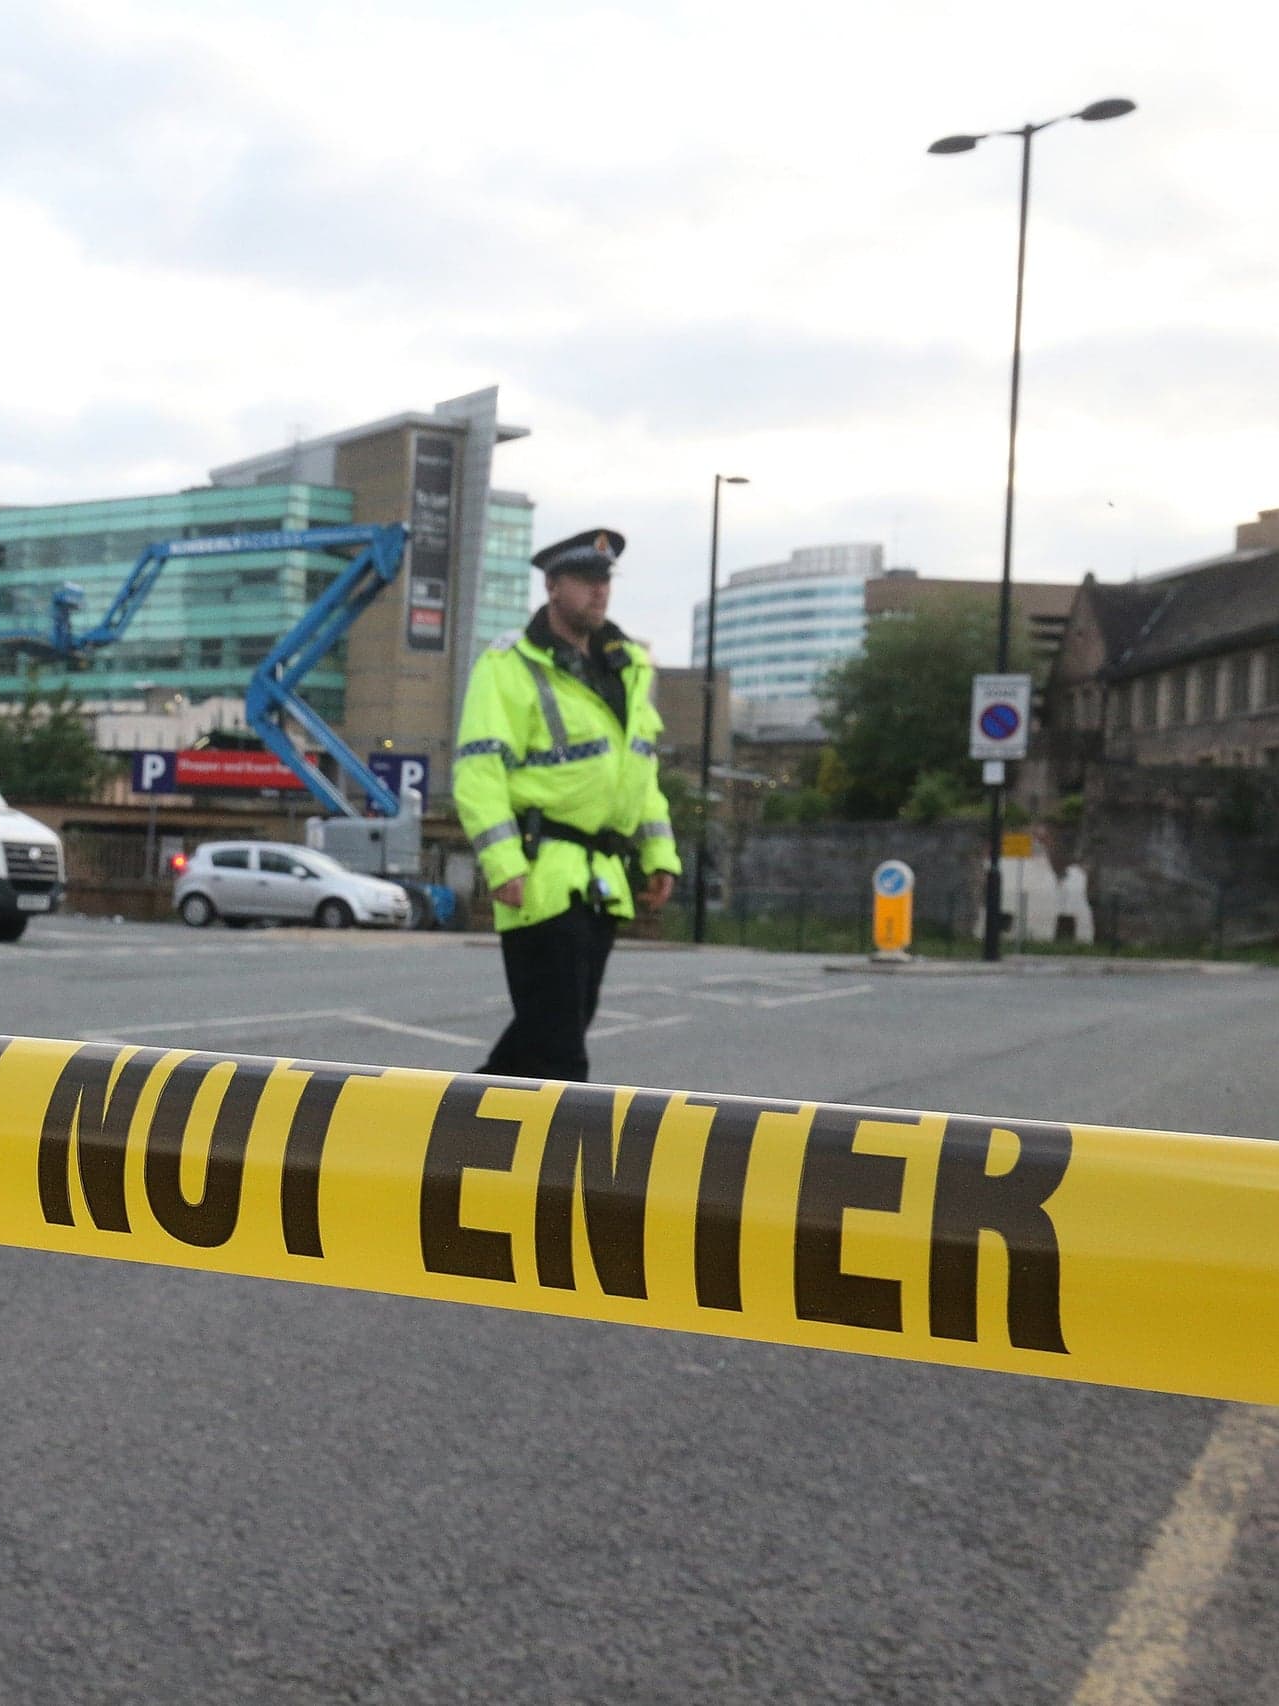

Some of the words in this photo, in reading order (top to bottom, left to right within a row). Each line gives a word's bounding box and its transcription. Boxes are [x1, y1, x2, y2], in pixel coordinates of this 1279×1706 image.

[142, 754, 166, 790] P
[401, 760, 424, 790] P
[37, 1043, 382, 1258] NOT
[420, 1073, 1071, 1354] ENTER
